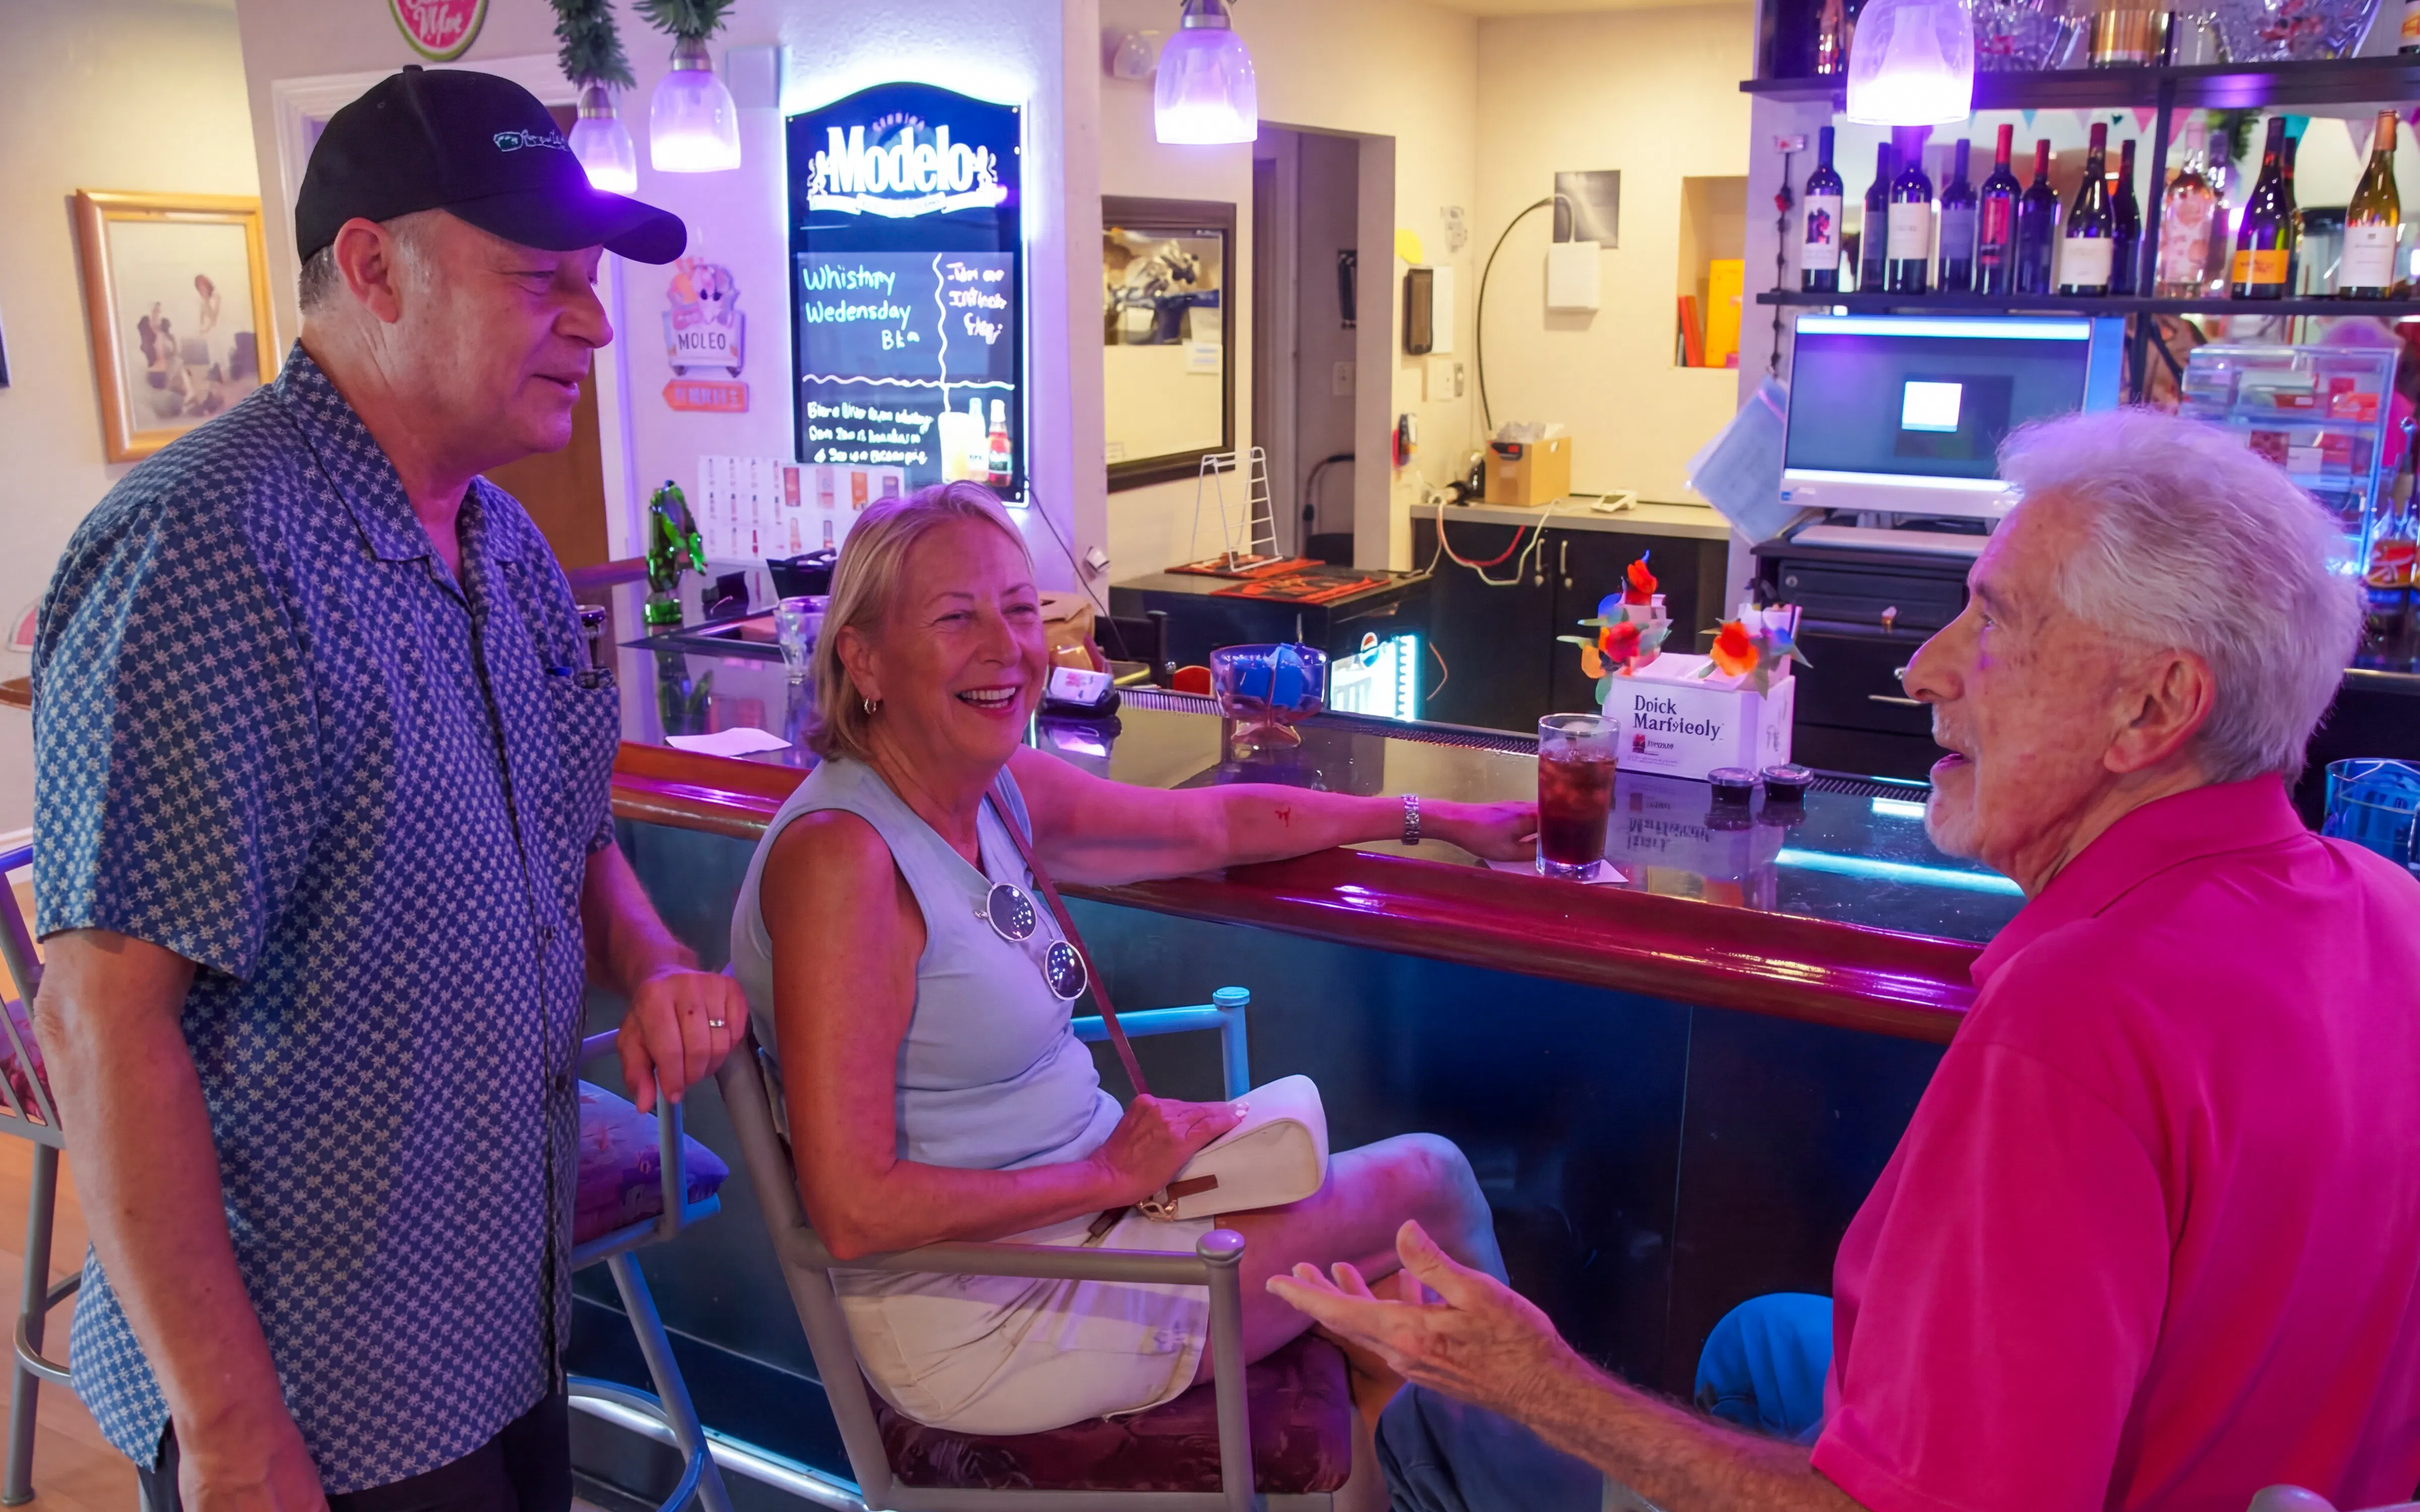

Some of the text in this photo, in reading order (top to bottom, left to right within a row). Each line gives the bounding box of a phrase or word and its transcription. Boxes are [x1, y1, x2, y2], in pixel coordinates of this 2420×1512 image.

[826, 124, 974, 193] Modelo
[805, 299, 912, 331] Wedensday
[678, 332, 726, 350] MOLEO
